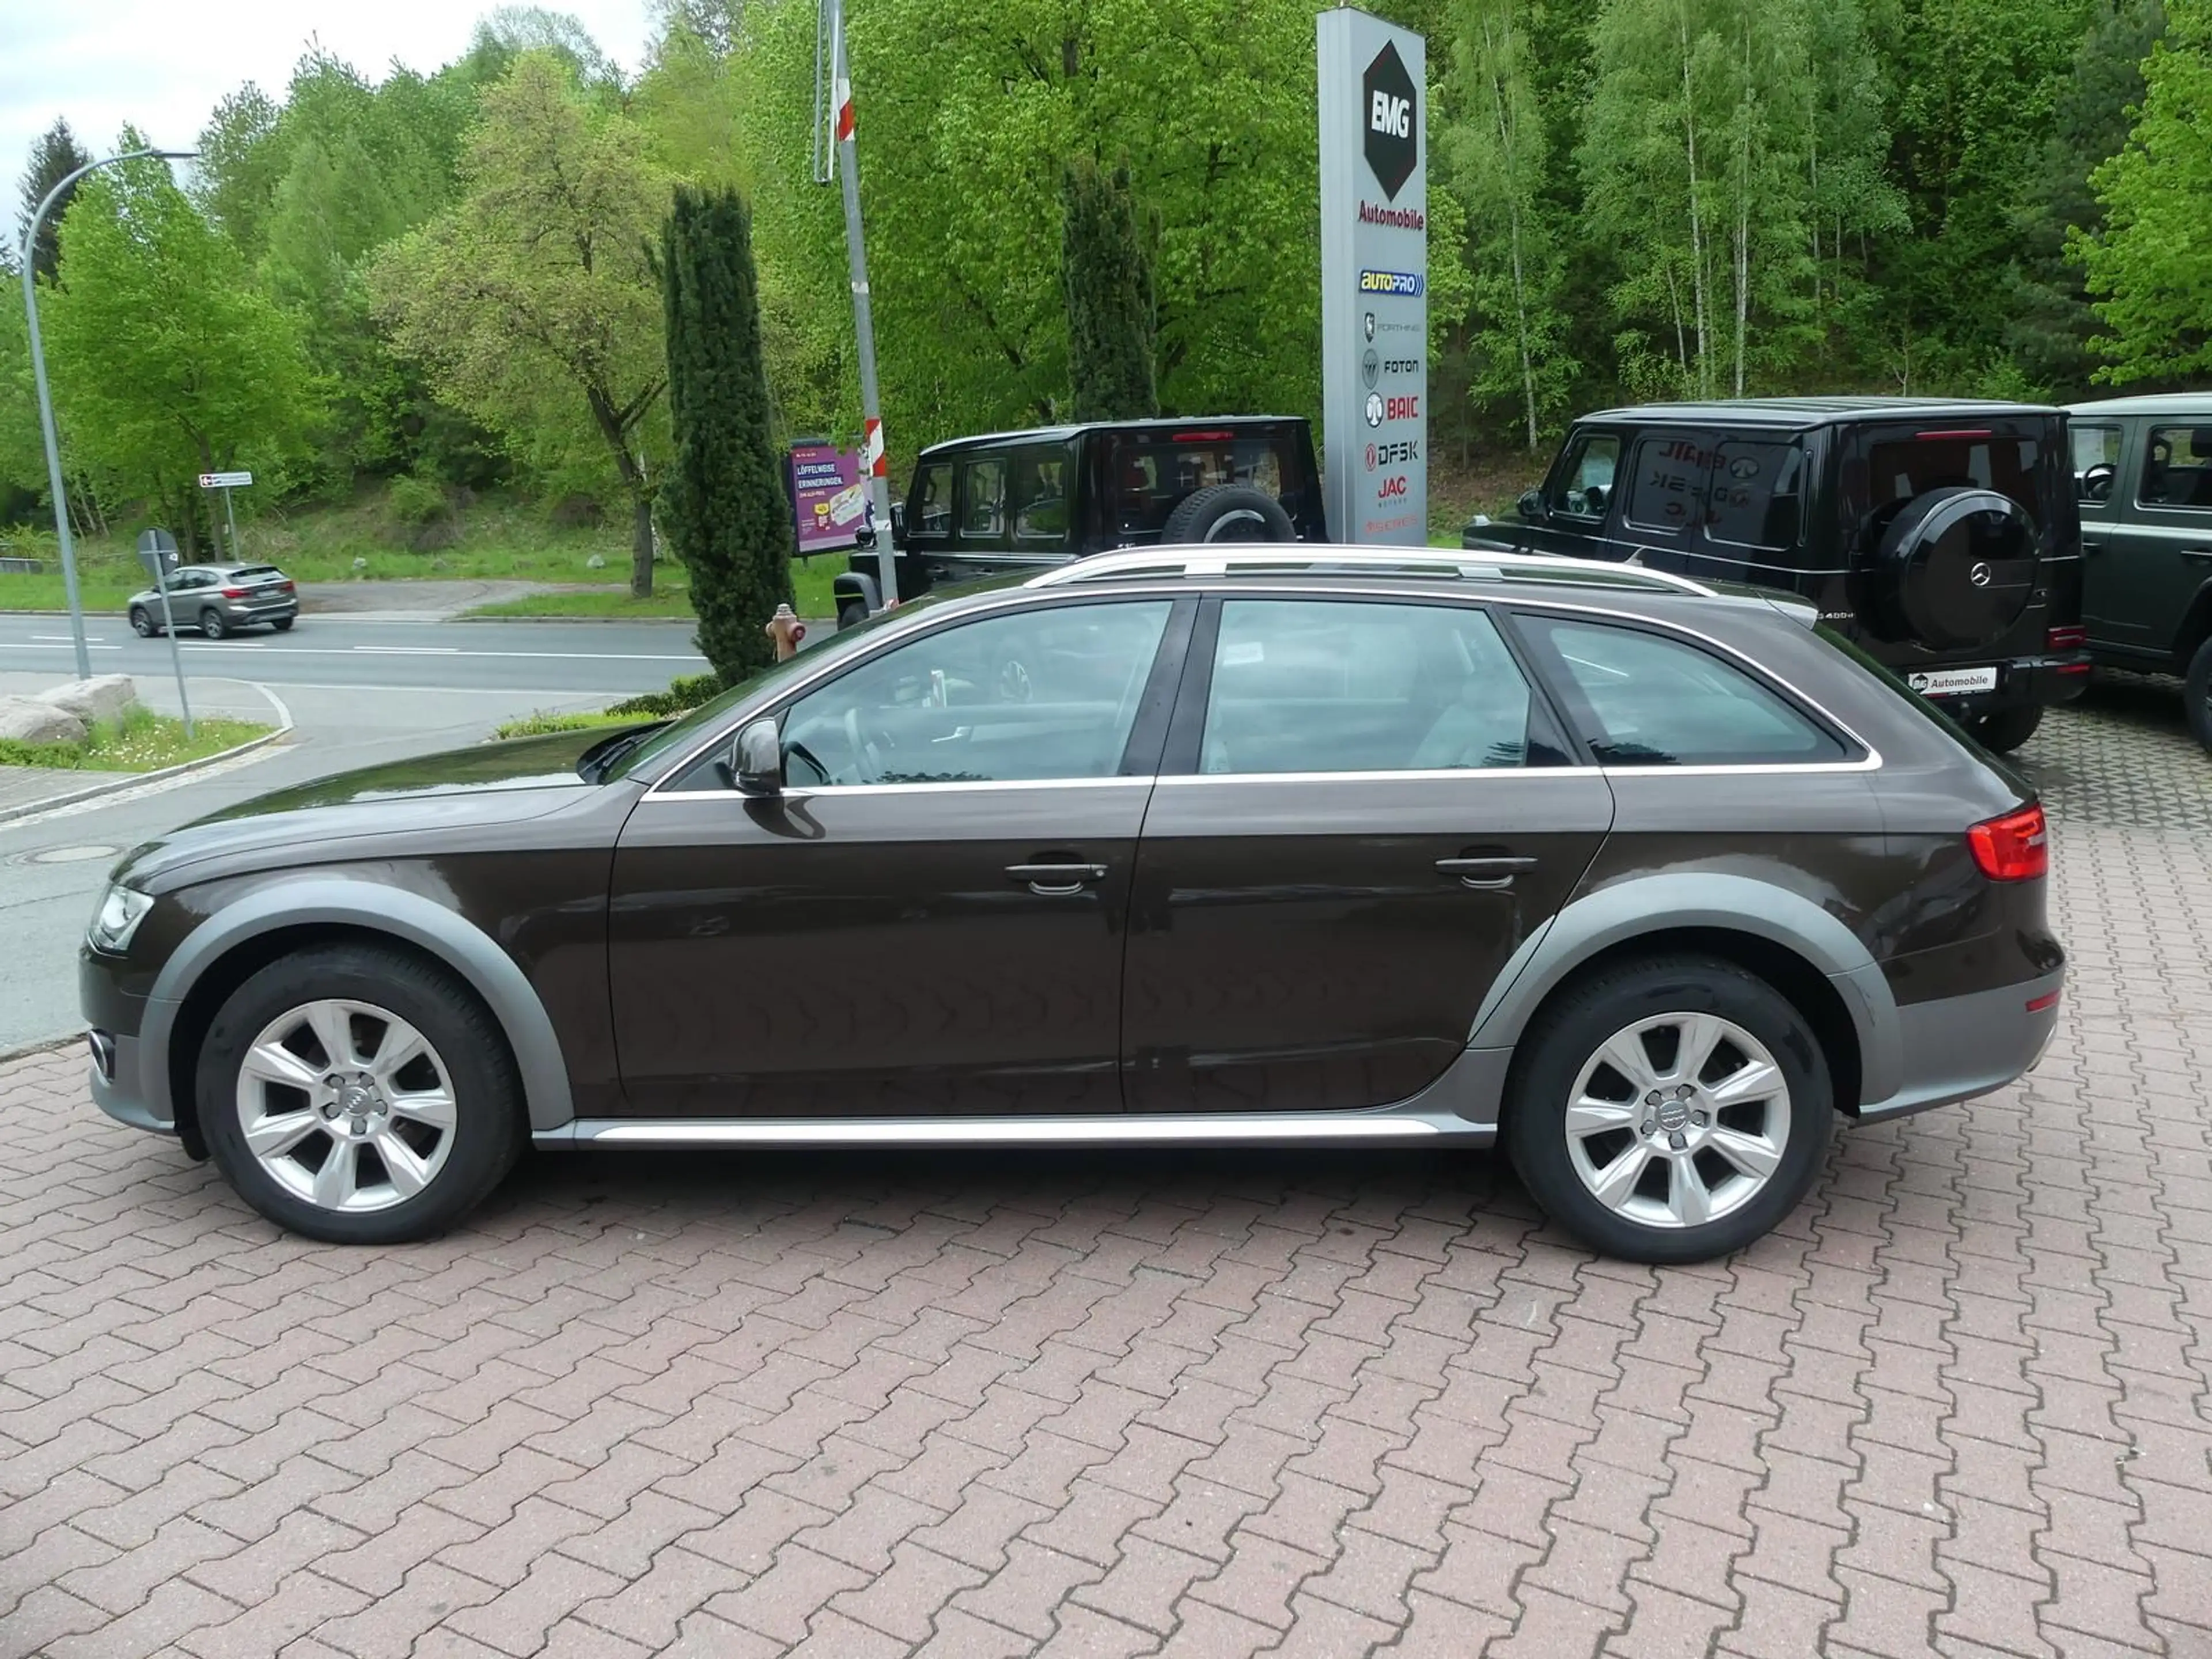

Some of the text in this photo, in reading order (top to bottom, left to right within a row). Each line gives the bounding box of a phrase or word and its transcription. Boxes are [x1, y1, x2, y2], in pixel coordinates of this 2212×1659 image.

[1372, 90, 1410, 138] EMG
[1358, 199, 1423, 230] Automobile
[1384, 359, 1419, 373] FOTON
[1388, 396, 1418, 420] BAIC
[1378, 440, 1418, 465] DFSK
[1378, 475, 1407, 498] JAC
[1931, 676, 1988, 688] Automobile
